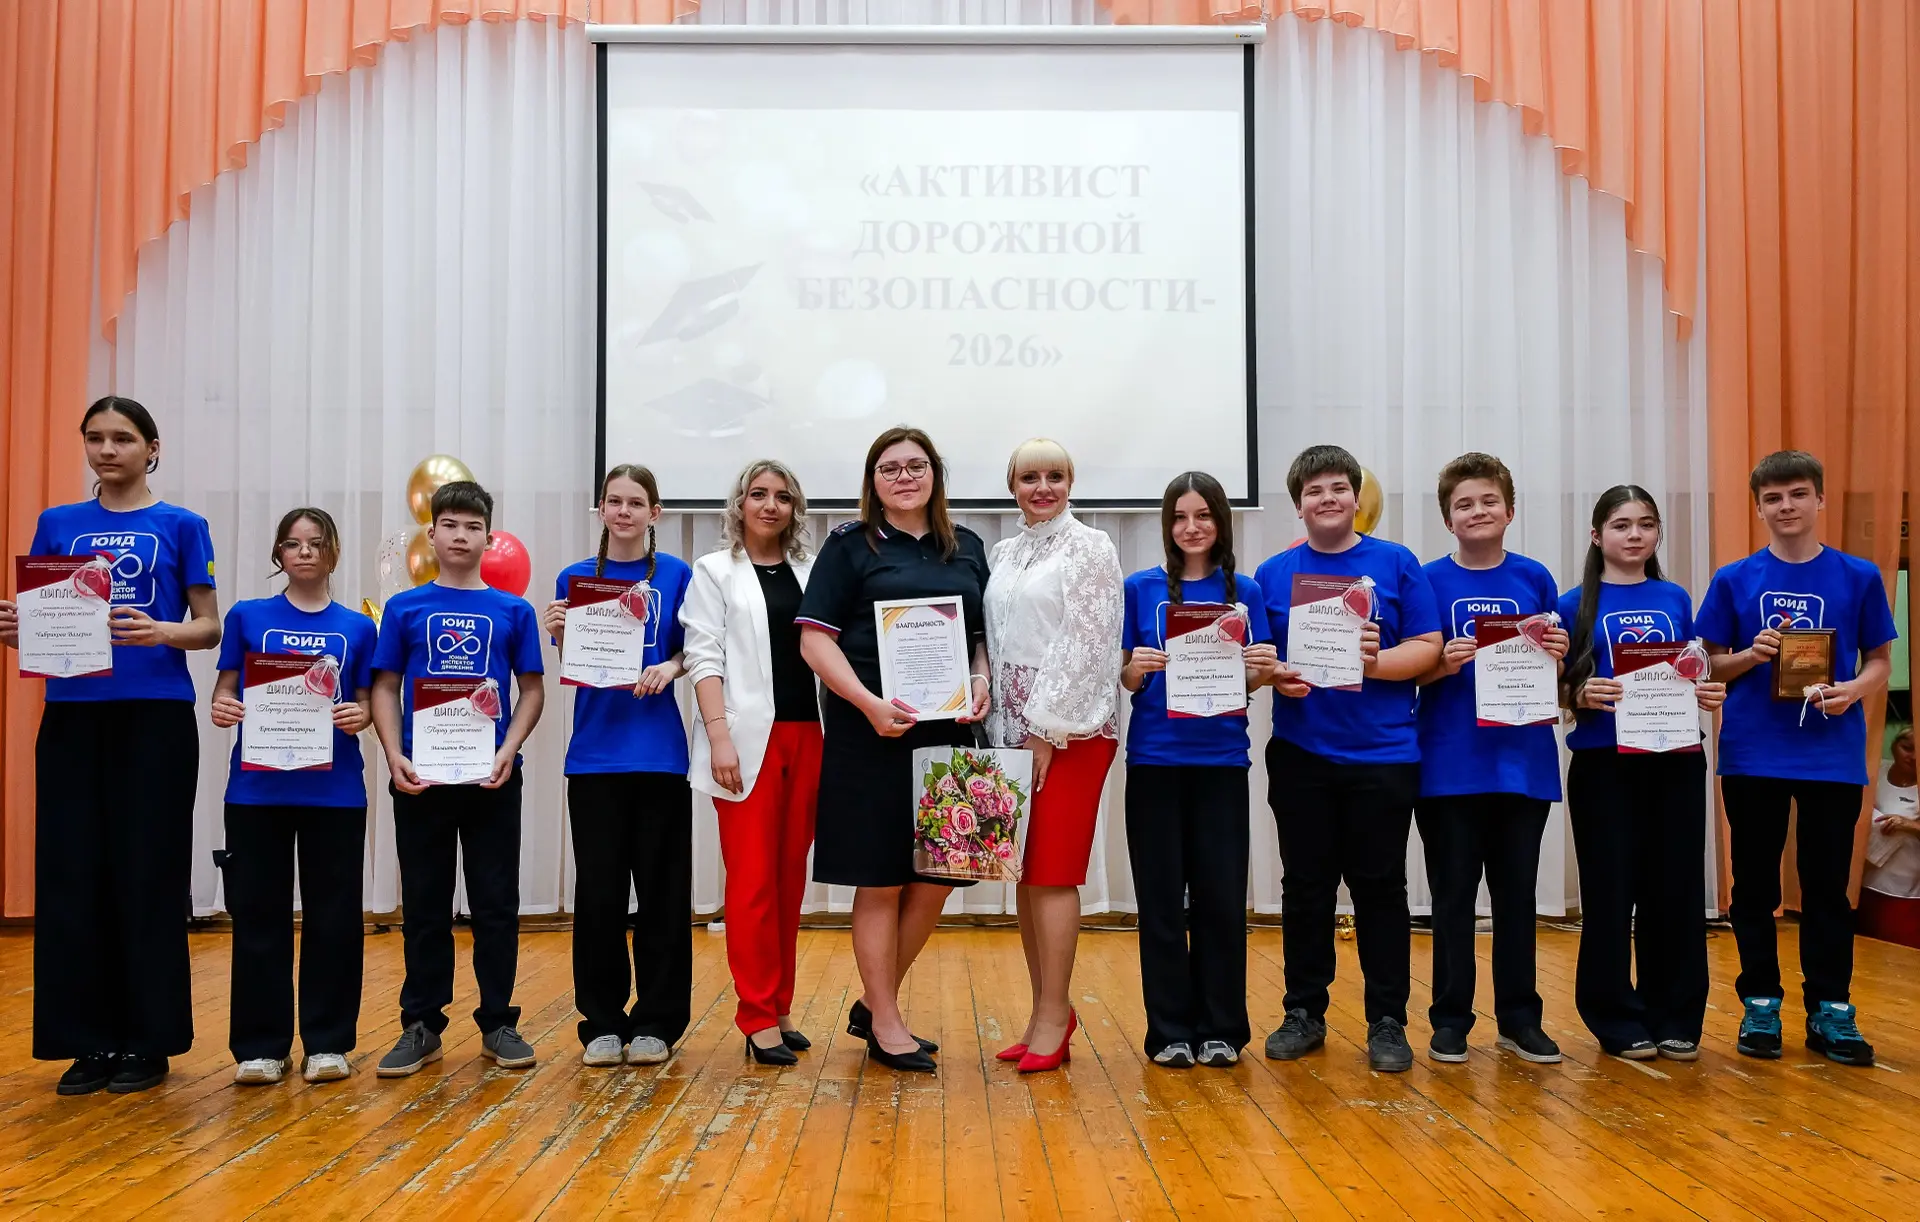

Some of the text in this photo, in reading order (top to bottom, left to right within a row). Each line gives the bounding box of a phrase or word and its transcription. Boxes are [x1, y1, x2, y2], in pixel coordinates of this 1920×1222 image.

[859, 164, 1151, 198] «АКТИВИСТ
[851, 212, 1146, 261] ДОРОЖНОЙ
[795, 276, 1216, 314] БЕЗОПАСНОСТИ-
[946, 333, 1064, 368] 2026»
[91, 535, 136, 547] ЮИД
[40, 588, 82, 599] ДИПЛО
[1467, 603, 1502, 614] ЮИД
[1773, 598, 1808, 611] ЮИД
[586, 605, 626, 618] ДИПЛО
[442, 618, 476, 630] ЮИД
[1619, 615, 1655, 624] ЮИД
[283, 635, 326, 648] ЮИД
[1185, 634, 1221, 645] ДИПЛО
[1495, 644, 1536, 654] ДИПЛОМ
